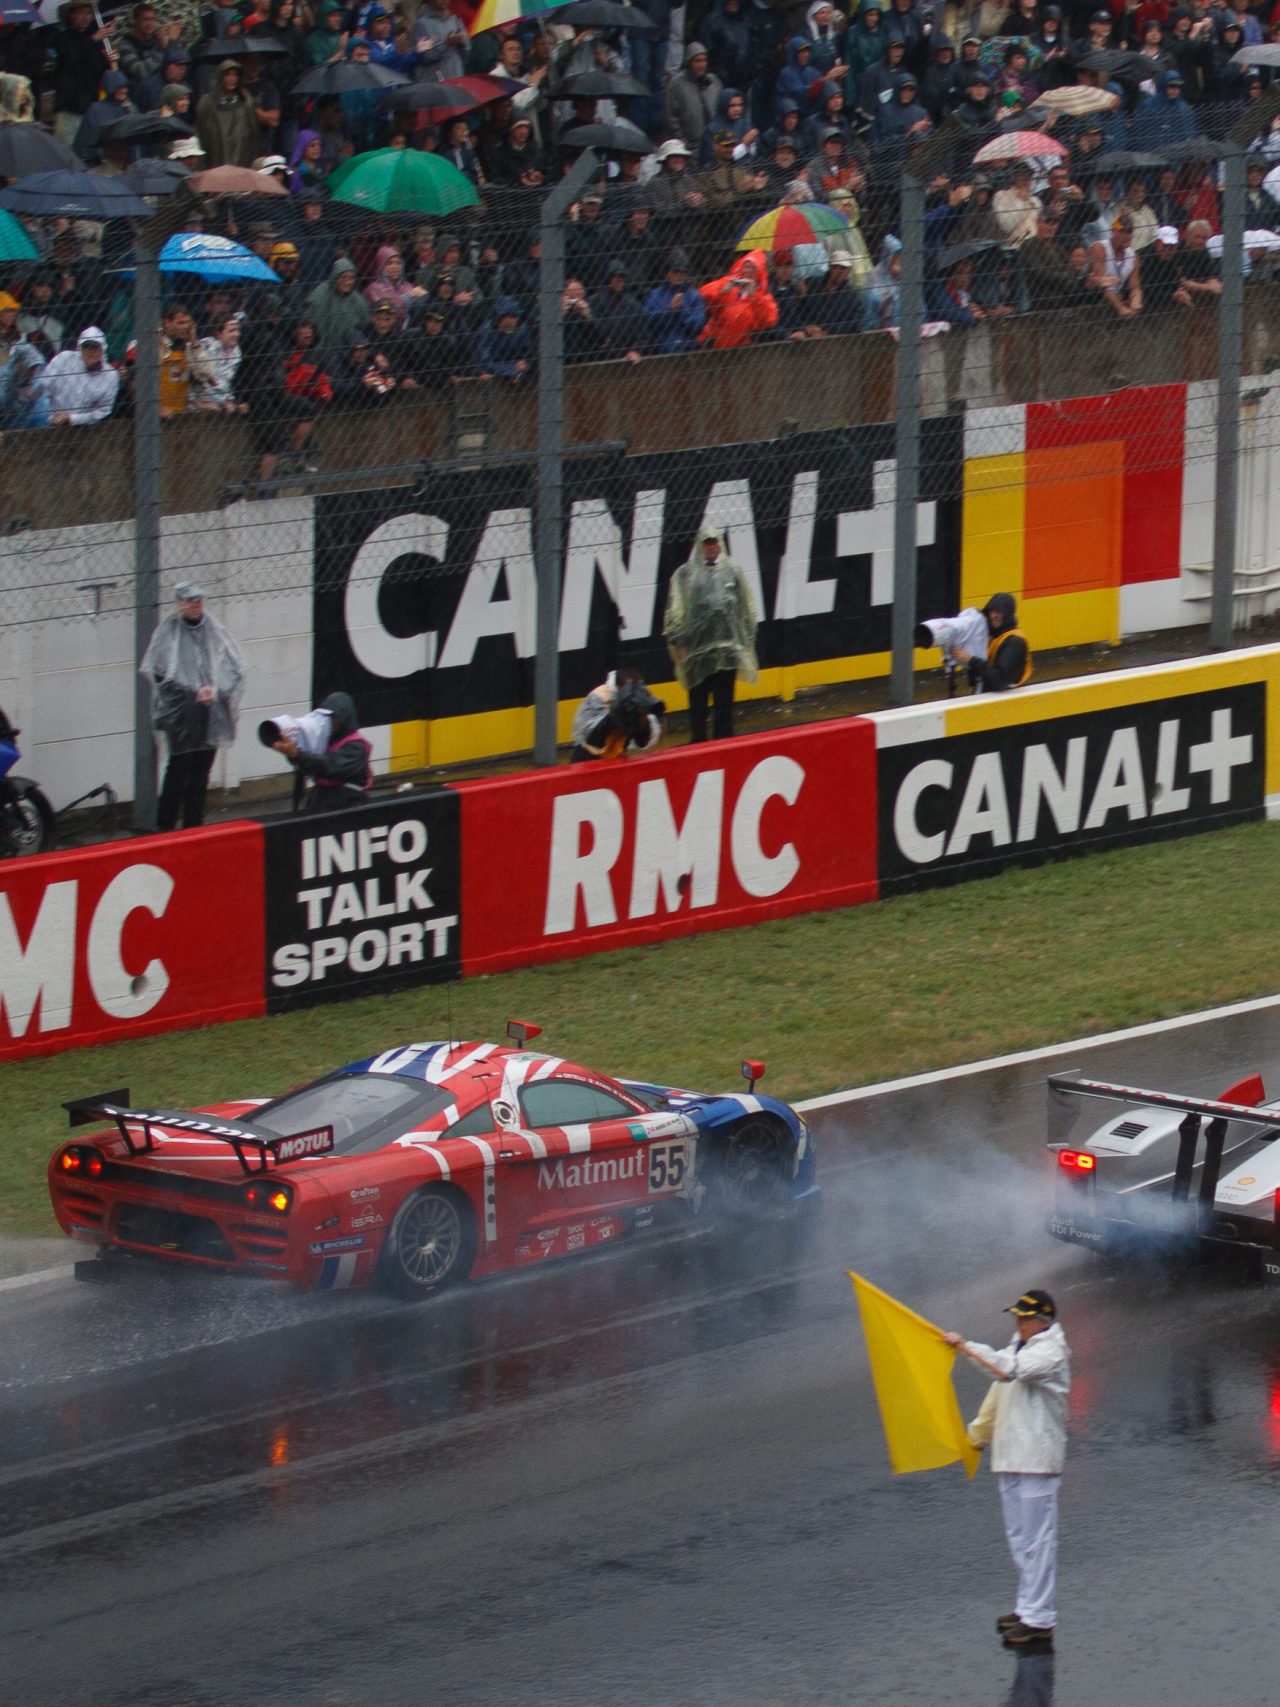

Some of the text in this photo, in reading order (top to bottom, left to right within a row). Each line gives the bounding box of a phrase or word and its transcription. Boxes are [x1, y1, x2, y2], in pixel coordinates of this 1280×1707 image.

[344, 458, 936, 679] CANAL+
[893, 707, 1253, 864] CANAL+
[300, 818, 428, 882] INFO
[543, 755, 806, 936] RMC
[297, 867, 435, 931] TALK
[272, 914, 459, 988] SPORT
[279, 1131, 331, 1159] MOTUL
[537, 1148, 645, 1190] Matmut
[650, 1146, 685, 1189] 55
[1051, 1224, 1103, 1241] TDI Power
